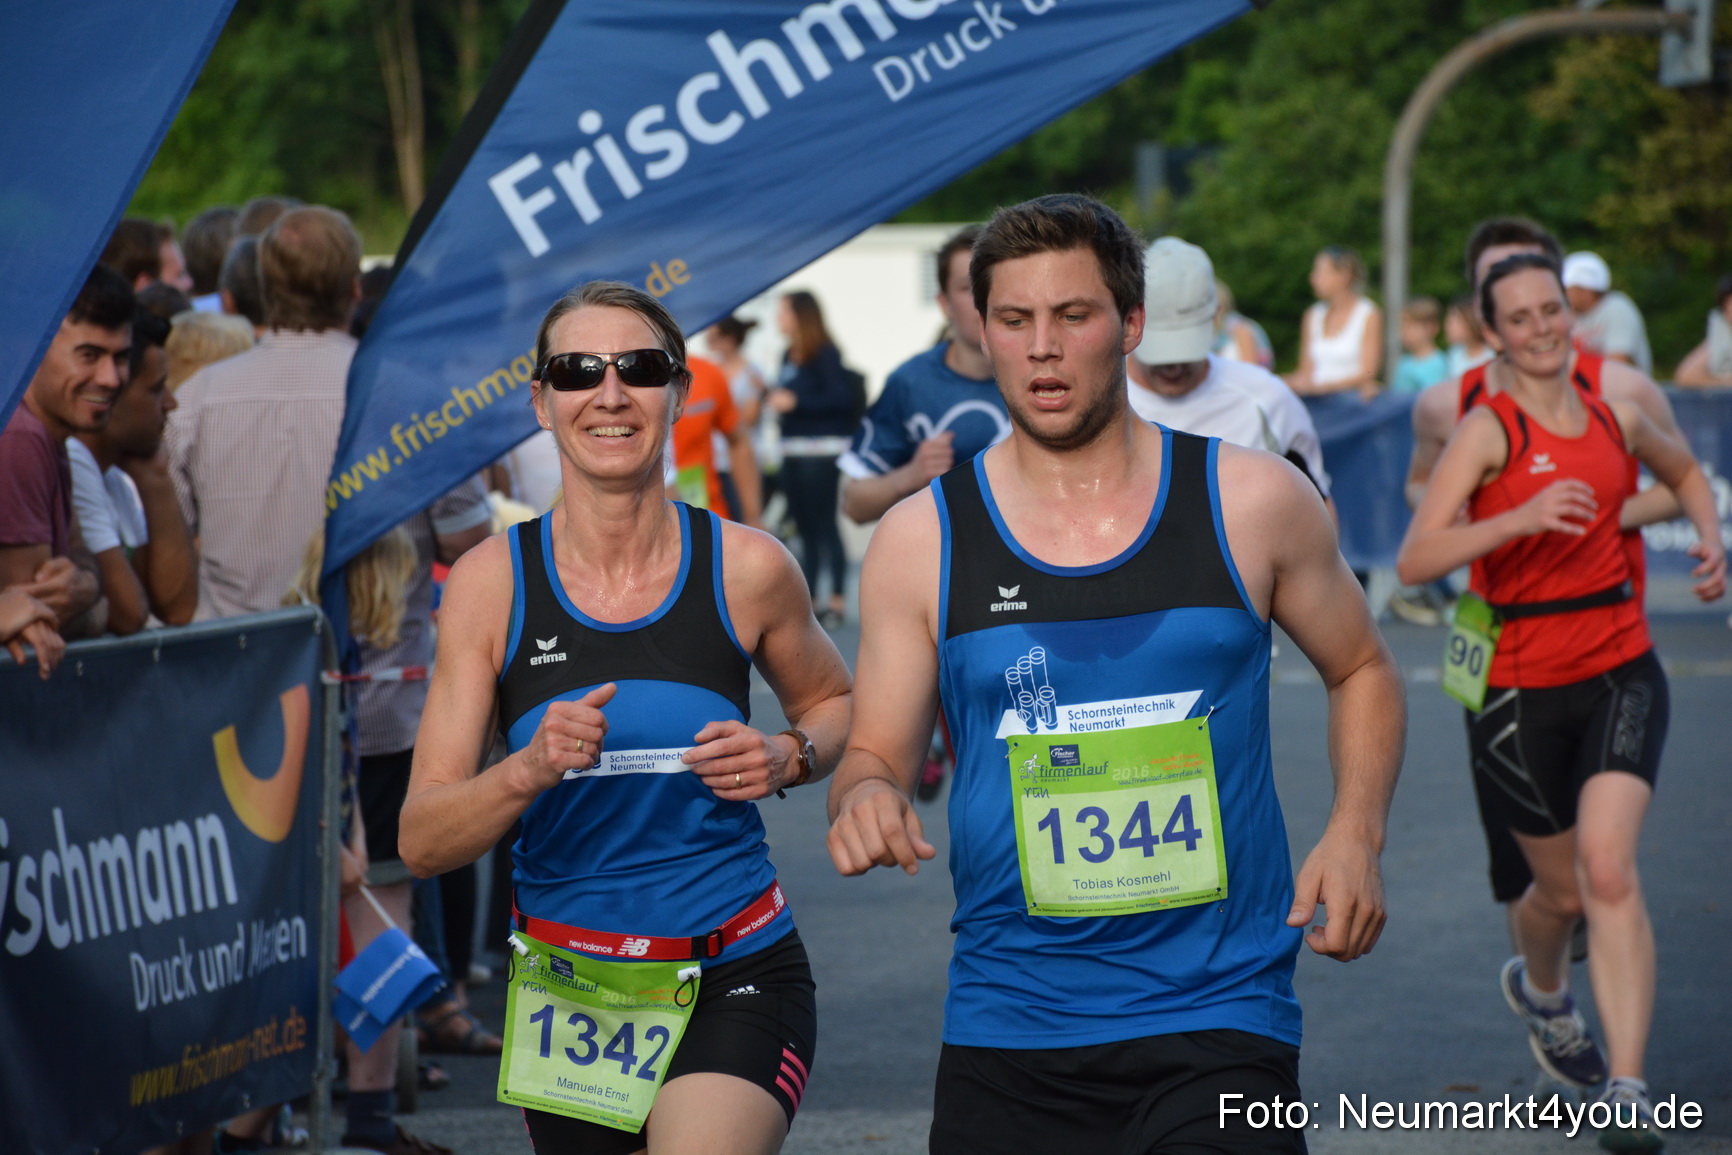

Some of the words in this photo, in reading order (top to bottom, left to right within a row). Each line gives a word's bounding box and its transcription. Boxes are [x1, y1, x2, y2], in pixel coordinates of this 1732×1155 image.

[872, 0, 1018, 102] Druck
[325, 346, 538, 518] www.frischma
[990, 600, 1027, 612] erima
[529, 652, 567, 666] erima
[1067, 699, 1176, 721] Schornsteintechnik
[1069, 717, 1126, 733] Neumarkt
[609, 752, 683, 763] Schornsteintech
[610, 762, 655, 772] Neumarkt
[1039, 761, 1109, 779] firmenlauf
[1112, 765, 1150, 780] 2016
[1038, 794, 1203, 865] 1344
[1072, 877, 1115, 890] Tobias
[1117, 870, 1171, 887] Kosmehl
[1067, 892, 1127, 902] Schornsteintechnik
[1128, 888, 1158, 898] Neumarkt
[1160, 885, 1180, 894] GmbH
[569, 939, 582, 949] new
[582, 940, 613, 954] balance
[129, 936, 197, 1013] Druck
[199, 921, 246, 993] und
[540, 965, 600, 994] firmenlauf
[529, 1004, 670, 1082] 1342
[557, 1076, 603, 1096] Manuela
[605, 1087, 630, 1103] Ernst
